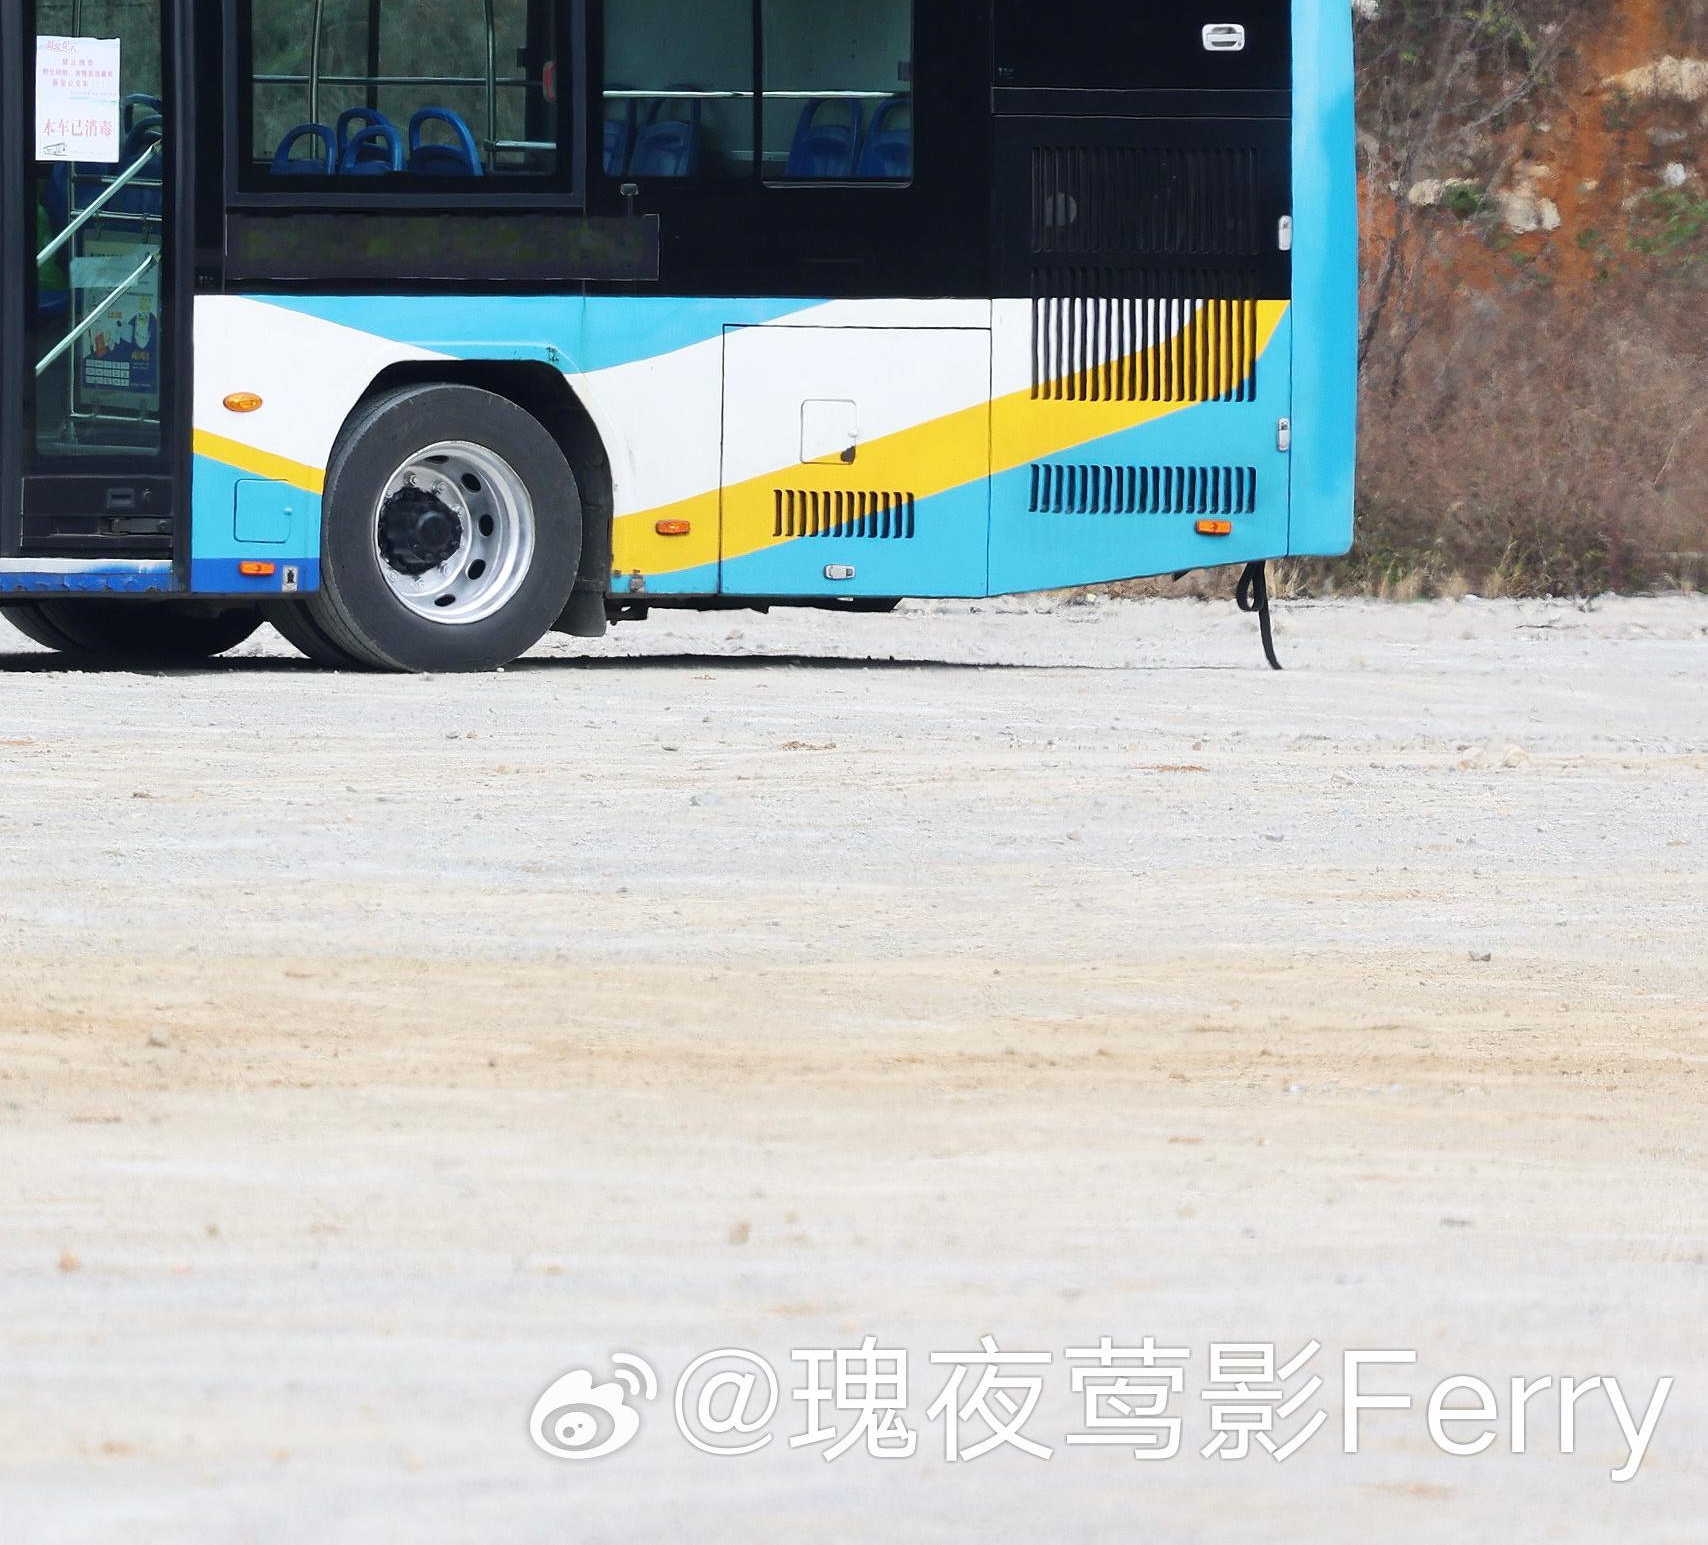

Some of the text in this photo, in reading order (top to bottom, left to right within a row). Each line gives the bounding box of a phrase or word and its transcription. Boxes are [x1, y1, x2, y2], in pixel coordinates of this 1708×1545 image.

[43, 118, 113, 137] 本车已消毒
